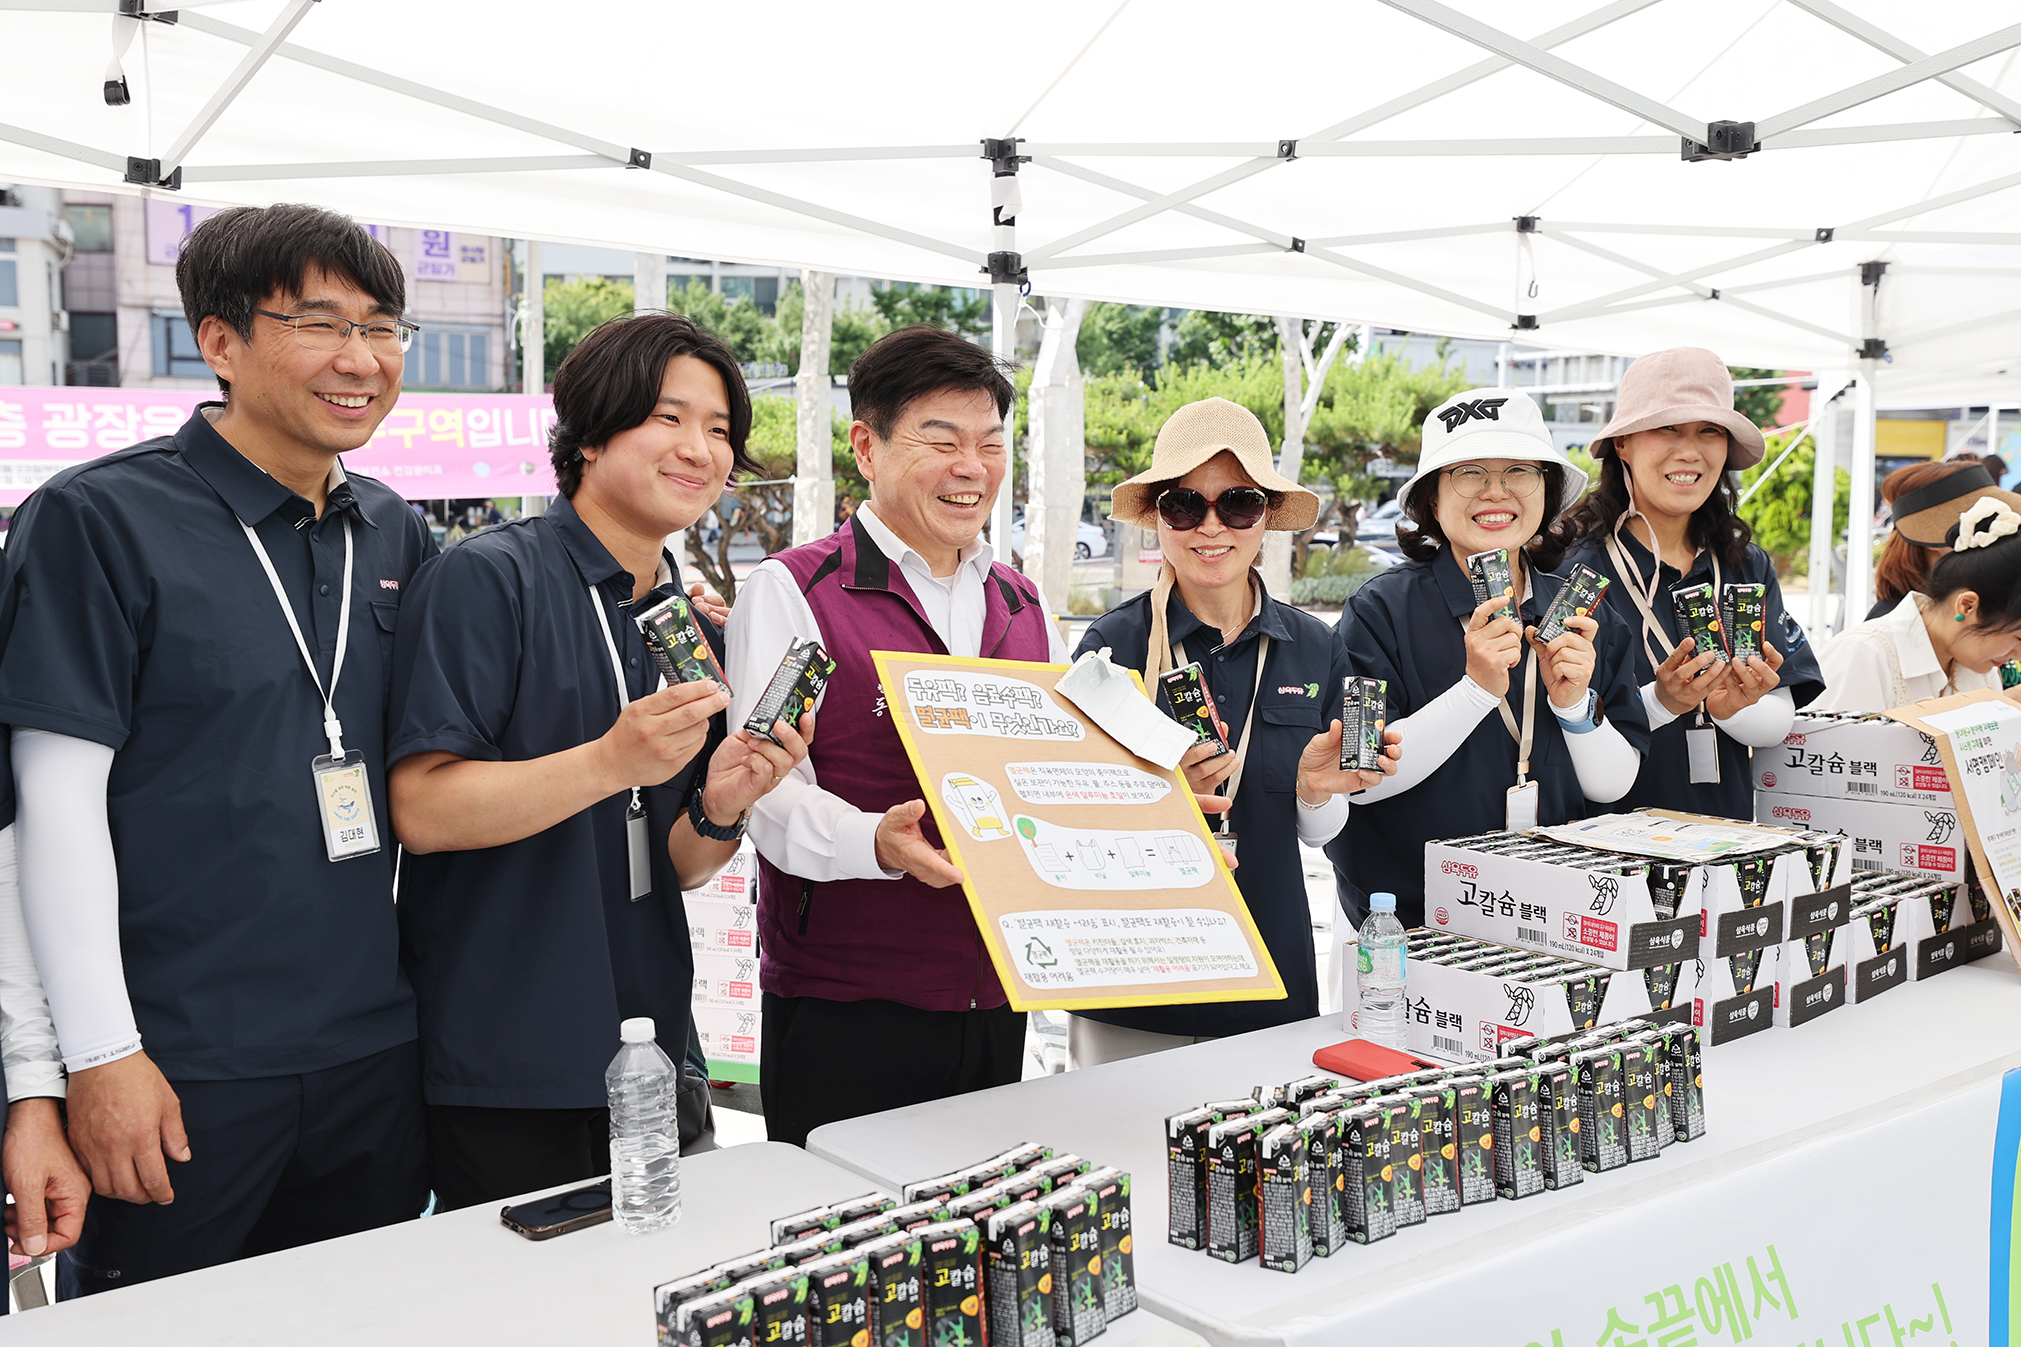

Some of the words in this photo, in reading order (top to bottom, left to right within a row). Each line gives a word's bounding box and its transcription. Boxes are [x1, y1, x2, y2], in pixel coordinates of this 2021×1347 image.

[1437, 398, 1509, 433] PXG
[665, 625, 696, 648] 고칼슘
[907, 677, 967, 702] 두유팩?
[971, 683, 1043, 710] 음료수팩?
[1174, 687, 1201, 704] 고칼슘
[1277, 686, 1305, 695] 삼육두유
[915, 705, 987, 729] 멸균팩이
[990, 711, 1080, 738] 무엇인가요?
[1784, 747, 1846, 776] 고칼슘
[1849, 760, 1878, 777] 블랙
[1965, 751, 2004, 776] 서명캠페인
[1772, 806, 1811, 821] 삼육두유
[340, 827, 364, 843] 김대현
[1854, 837, 1883, 854] 블랙
[1054, 874, 1068, 882] 종이
[1094, 872, 1108, 880] 비닐
[1441, 860, 1479, 879] 삼육두유
[1457, 880, 1516, 918] 고칼슘
[1519, 902, 1547, 924] 블랙
[1583, 927, 1598, 937] 소중한
[1599, 931, 1615, 941] 제품이
[1549, 940, 1557, 949] 190
[1024, 972, 1048, 984] 재활용
[1049, 971, 1074, 983] 어려움
[1435, 1009, 1462, 1033] 블랙
[1596, 1080, 1620, 1095] 고칼슘
[1628, 1072, 1652, 1087] 고칼슘
[1514, 1102, 1538, 1118] 고칼슘
[1555, 1094, 1577, 1110] 고칼슘
[1461, 1109, 1490, 1125] 고칼슘
[1422, 1118, 1453, 1134] 고칼슘
[1391, 1128, 1419, 1145] 고칼슘
[1366, 1139, 1390, 1157] 고칼슘
